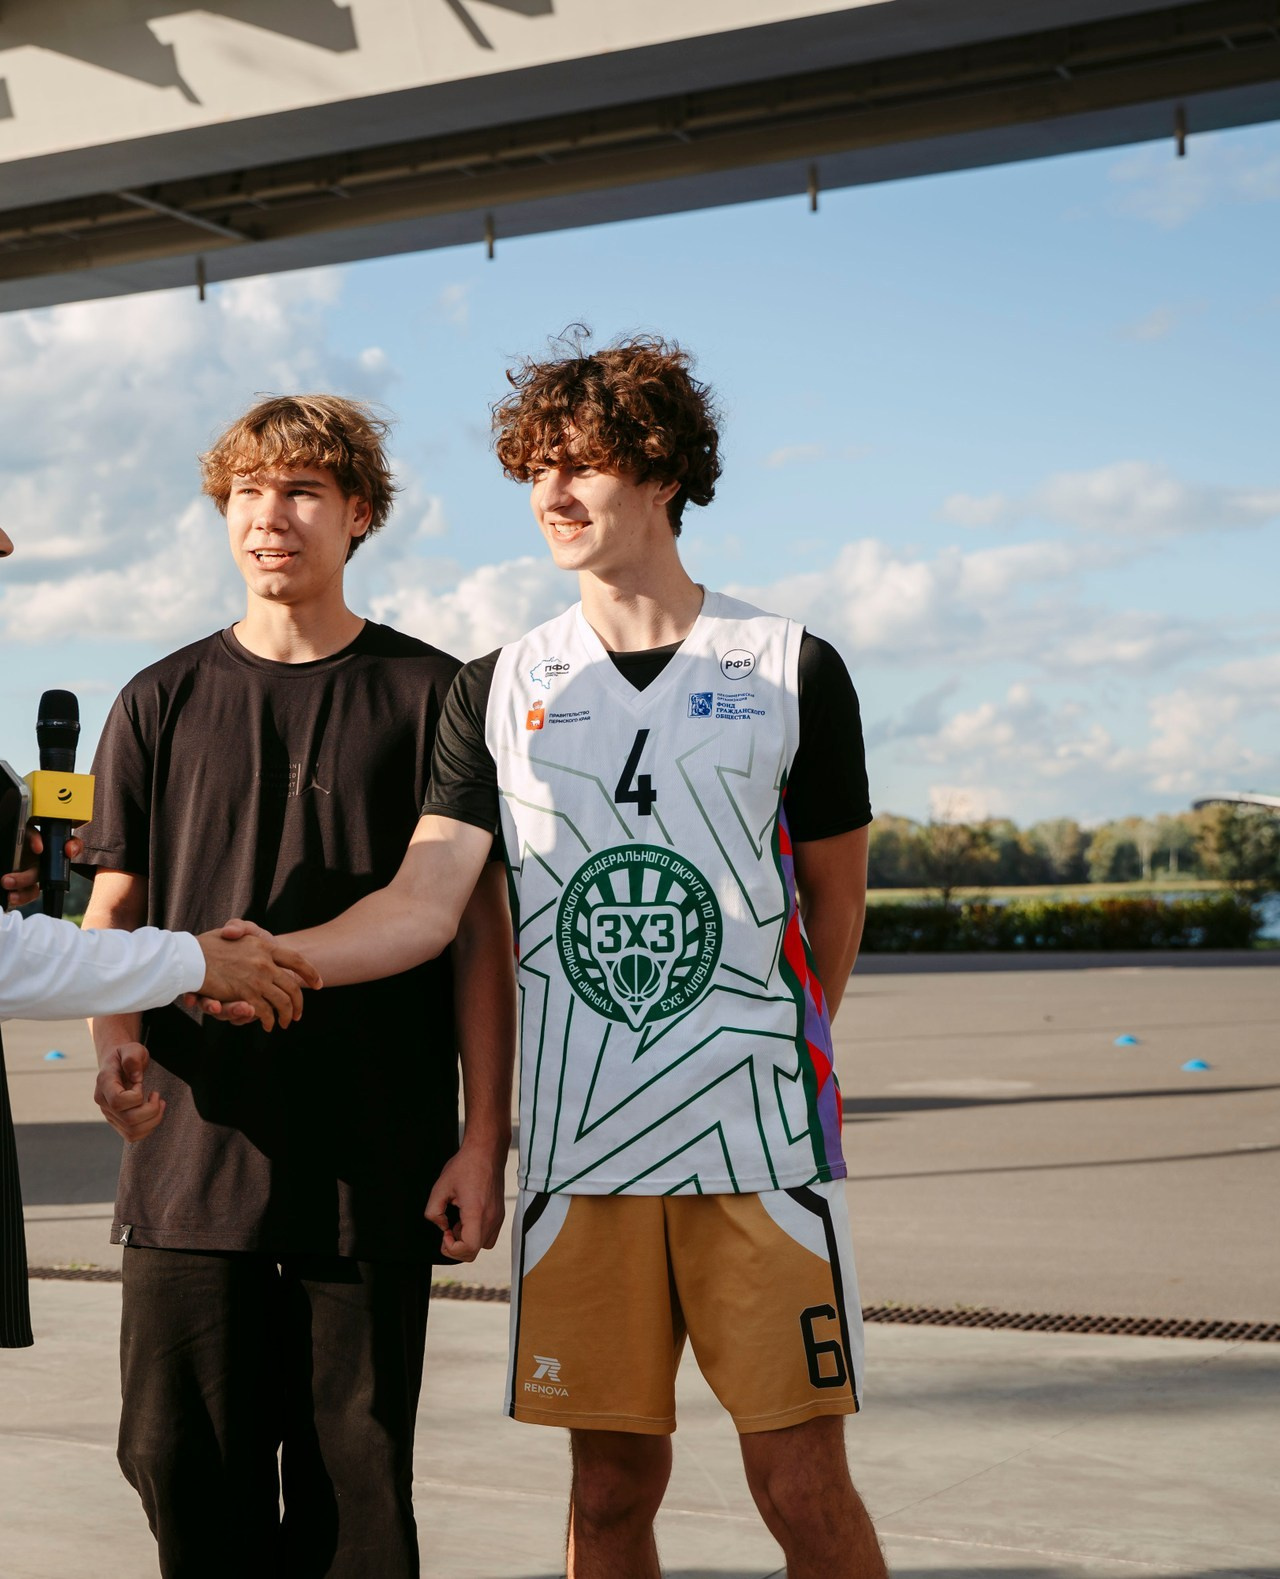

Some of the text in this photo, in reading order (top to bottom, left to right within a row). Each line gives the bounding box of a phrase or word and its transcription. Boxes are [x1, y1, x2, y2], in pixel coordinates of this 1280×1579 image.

[545, 663, 570, 672] ПФО
[725, 658, 751, 669] РФБ
[549, 710, 590, 718] ПРАВИТЕЛЬСТВО
[716, 708, 766, 716] ГРАЖДАНСКОГО
[614, 728, 658, 816] 4
[581, 850, 670, 884] ФЕДЕРАЛЬНОГО
[670, 860, 707, 900] ОКРУГА
[700, 901, 715, 918] ПО
[561, 882, 585, 980] ПРИВОЛЖСКОГО
[685, 921, 717, 997] БАСКЕТБОЛУ
[577, 980, 614, 1013] ТУРНИР
[799, 1303, 848, 1389] 6
[524, 1382, 569, 1397] RENOVA
